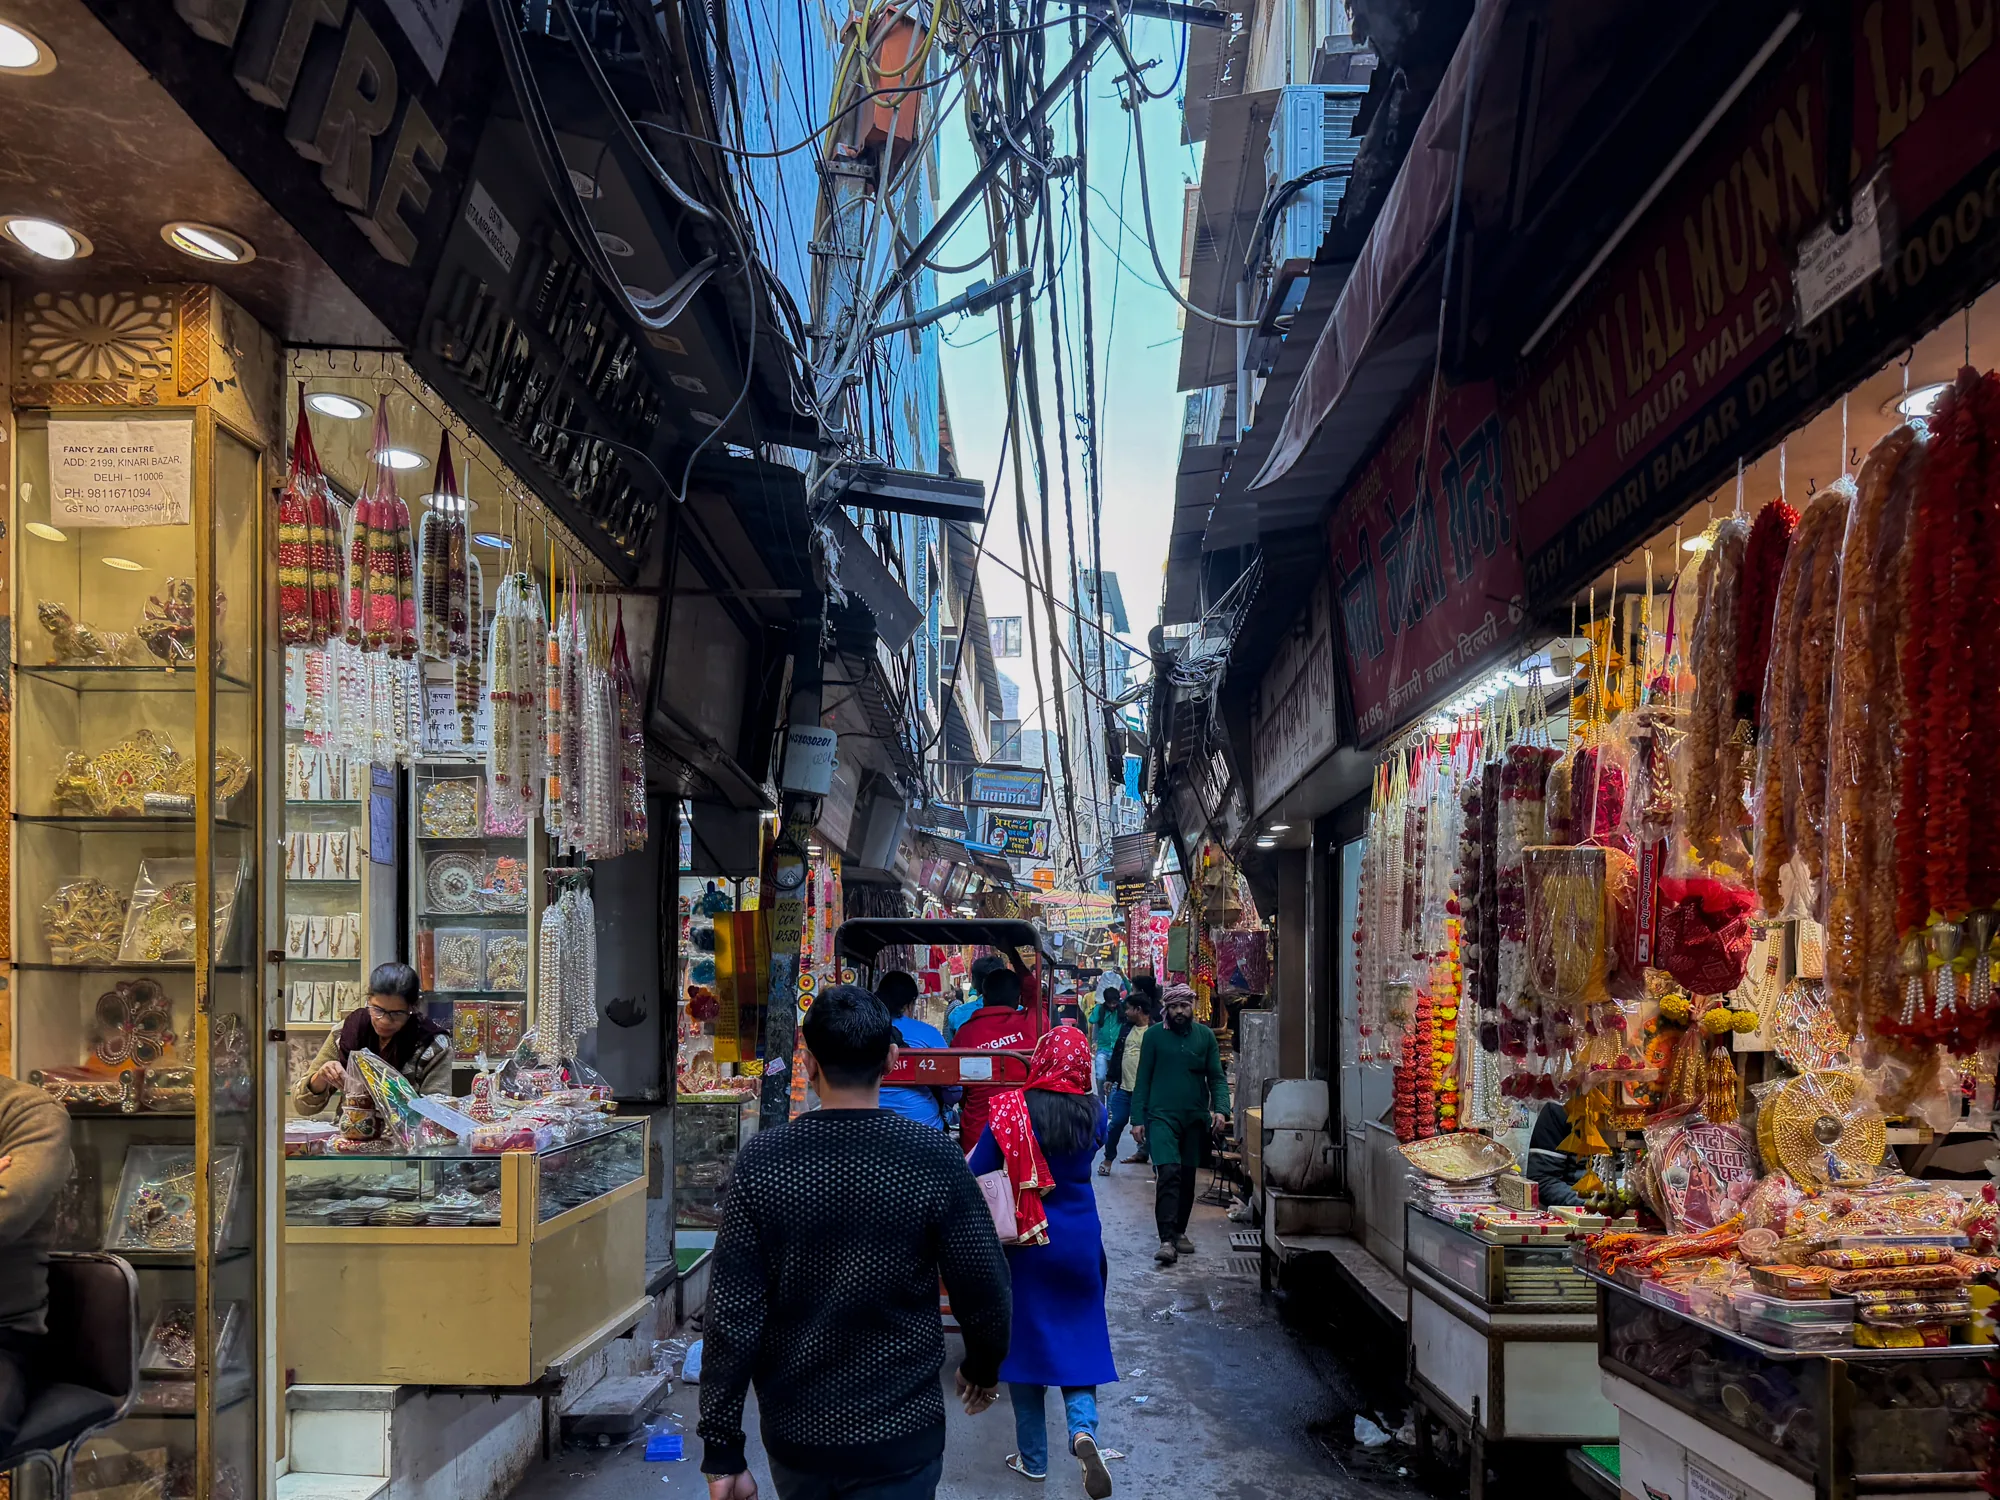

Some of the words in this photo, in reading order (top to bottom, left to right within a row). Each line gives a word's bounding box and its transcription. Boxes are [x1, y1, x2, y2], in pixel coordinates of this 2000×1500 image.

[1508, 315, 1616, 508] RATTAN
[1615, 245, 1686, 396] LAL
[1615, 372, 1688, 462] (MAUR
[1694, 279, 1782, 391] WALE)
[97, 446, 118, 454] ZARI
[63, 458, 87, 467] ADD:
[118, 458, 149, 467] KINARI
[94, 473, 123, 482] DELHI
[134, 472, 164, 481] 110006
[1577, 477, 1647, 548] KINARI
[1653, 403, 1740, 493] BAZAR
[64, 489, 84, 498] PH:
[87, 488, 151, 498] 9811671094
[65, 505, 84, 513] GST
[86, 505, 99, 513] NO
[1425, 650, 1456, 685] बजार
[777, 902, 800, 912] BSES
[990, 1034, 1017, 1049] GATE
[919, 1059, 936, 1070] 42
[1706, 1149, 1744, 1167] वाला
[1719, 1166, 1743, 1182] घर
